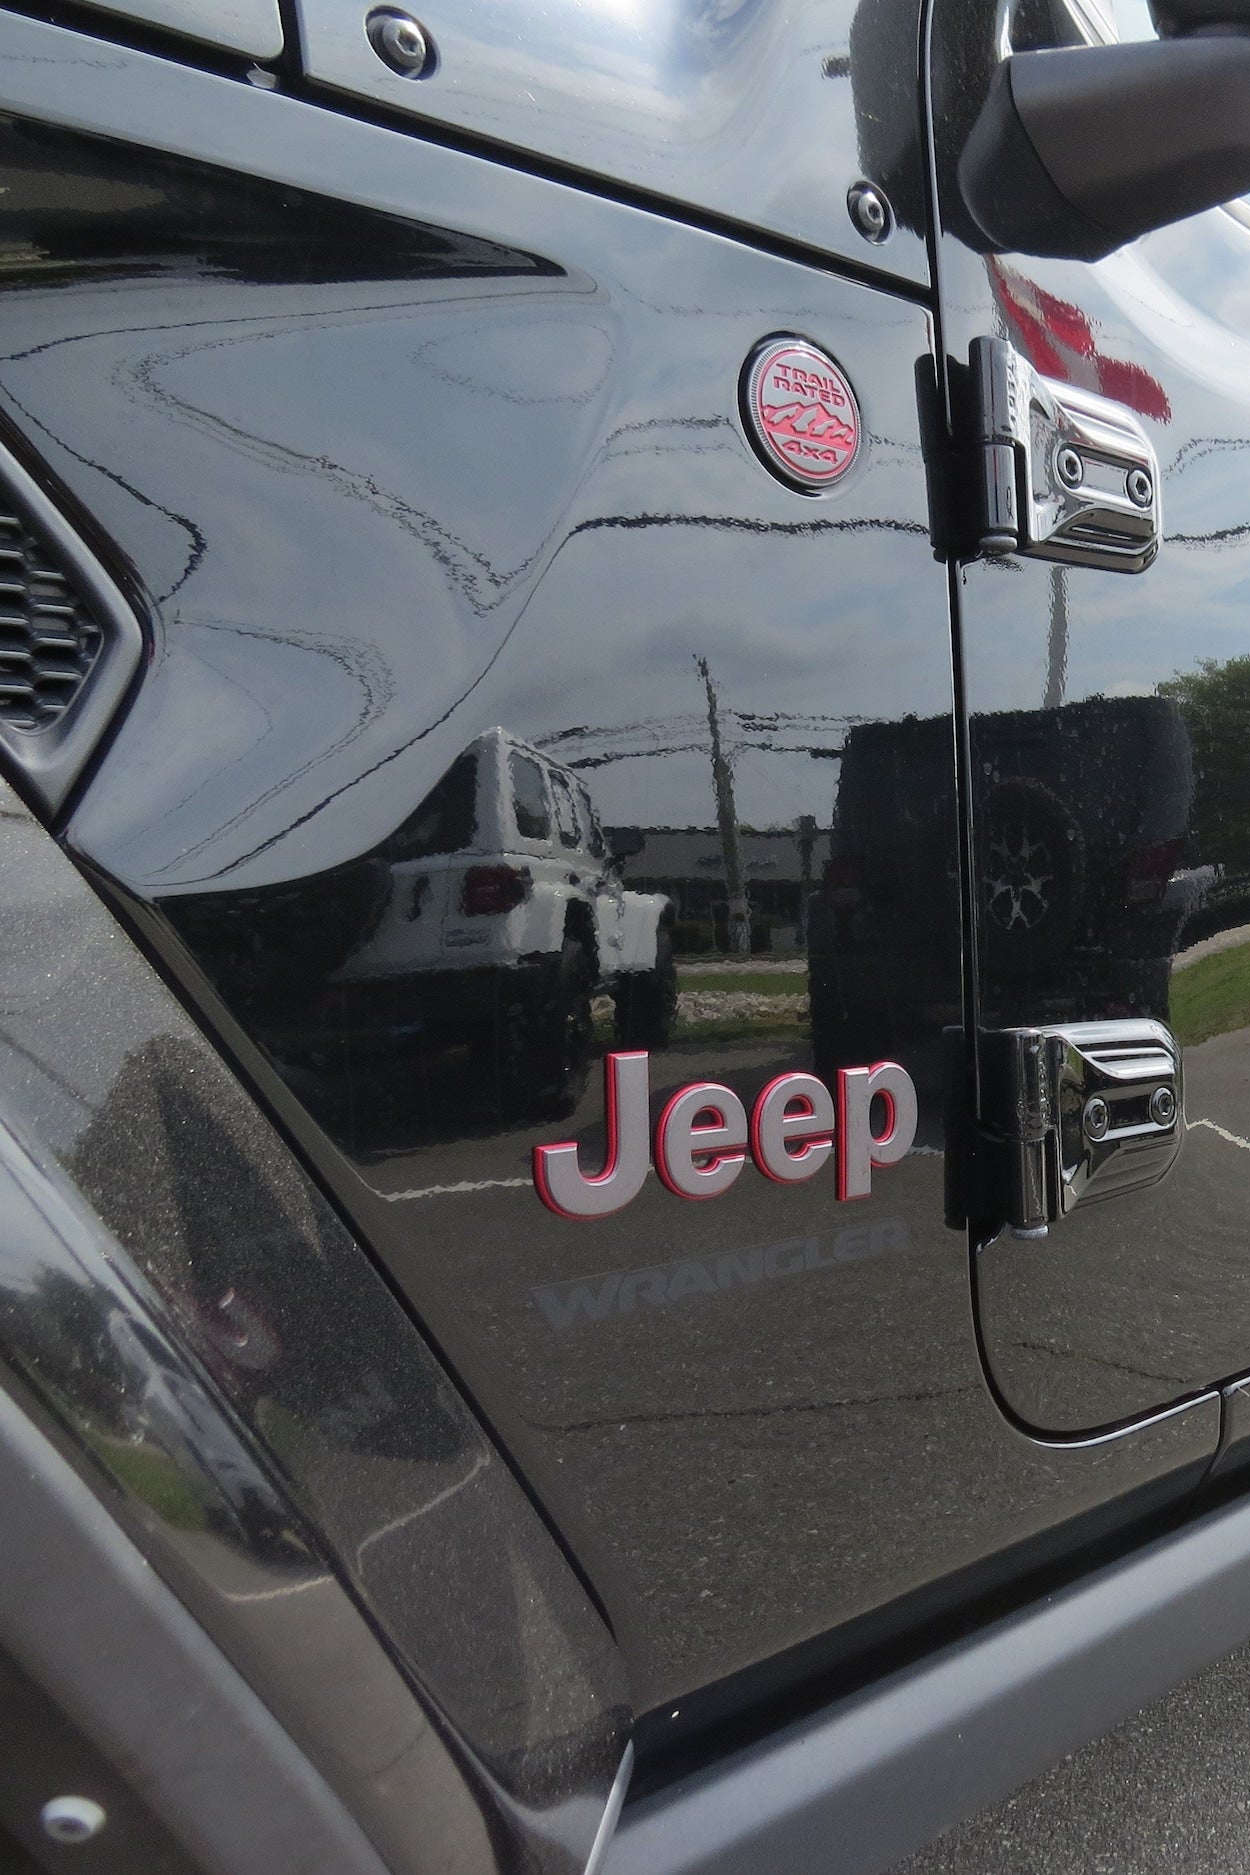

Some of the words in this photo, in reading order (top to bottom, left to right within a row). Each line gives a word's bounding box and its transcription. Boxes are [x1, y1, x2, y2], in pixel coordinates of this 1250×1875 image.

[773, 375, 845, 407] RATED
[776, 363, 841, 393] TRAIL
[534, 1051, 918, 1220] Jeep
[533, 1220, 911, 1330] WRANGLER
